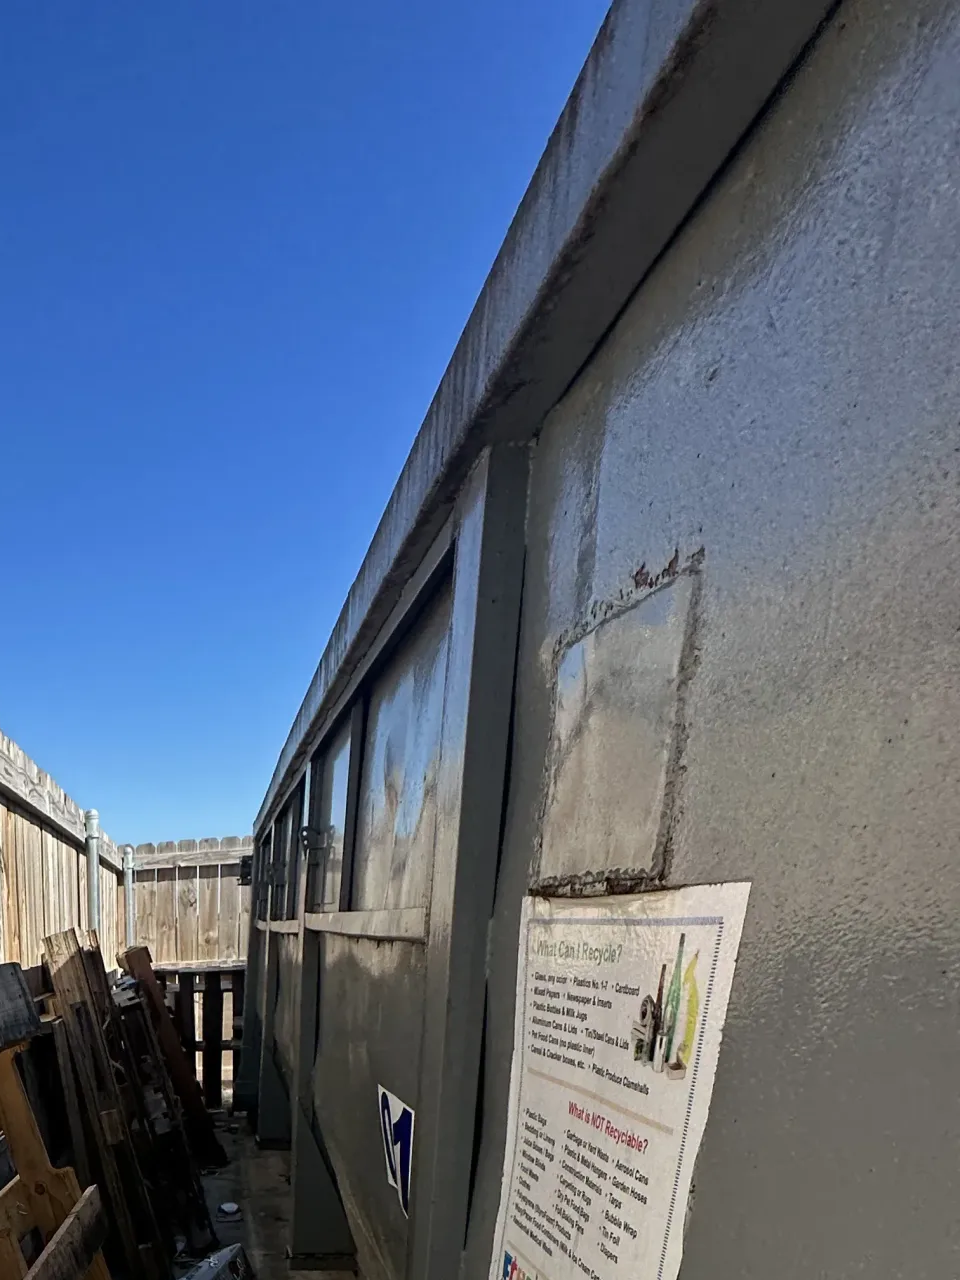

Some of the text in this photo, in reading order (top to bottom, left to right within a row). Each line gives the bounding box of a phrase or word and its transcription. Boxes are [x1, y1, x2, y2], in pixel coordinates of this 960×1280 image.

[536, 939, 557, 958] What
[558, 941, 575, 959] Can
[581, 942, 623, 966] Recycle?
[573, 976, 591, 988] Plastics
[615, 982, 640, 997] Cardboard
[533, 1000, 587, 1022] Plastic Bottles & Milk Jugs
[567, 992, 592, 1006] Newspaper
[597, 997, 612, 1009] Inserts
[532, 1016, 552, 1028] Aluminum
[552, 1020, 563, 1031] Cans
[563, 1023, 567, 1032] &
[568, 1024, 578, 1035] Lids
[605, 1033, 615, 1046] Cans
[615, 1036, 619, 1047] &
[619, 1039, 629, 1050] Lids
[538, 1032, 548, 1042] Food
[548, 1034, 559, 1045] Cans
[567, 1041, 582, 1052] plastic
[542, 1048, 546, 1057] &
[592, 1063, 605, 1077] Plastic
[605, 1068, 622, 1085] Produce
[623, 1076, 649, 1096] Clamshells
[567, 1129, 583, 1147] Garbage
[569, 1101, 648, 1154] What is NOT Recyclable?
[562, 1160, 585, 1183] Construction
[577, 1153, 580, 1162] &
[591, 1162, 608, 1181] Hangers
[615, 1159, 648, 1186] Aerosol Cans
[560, 1175, 577, 1197] Carpeting
[581, 1190, 591, 1206] Rugs
[609, 1192, 622, 1210] Tarps
[612, 1176, 647, 1205] Garden Hoses
[605, 1209, 637, 1239] Bubble Wrap
[609, 1232, 620, 1246] Foil
[600, 1242, 618, 1264] Diapers
[578, 1258, 590, 1276] Cream
